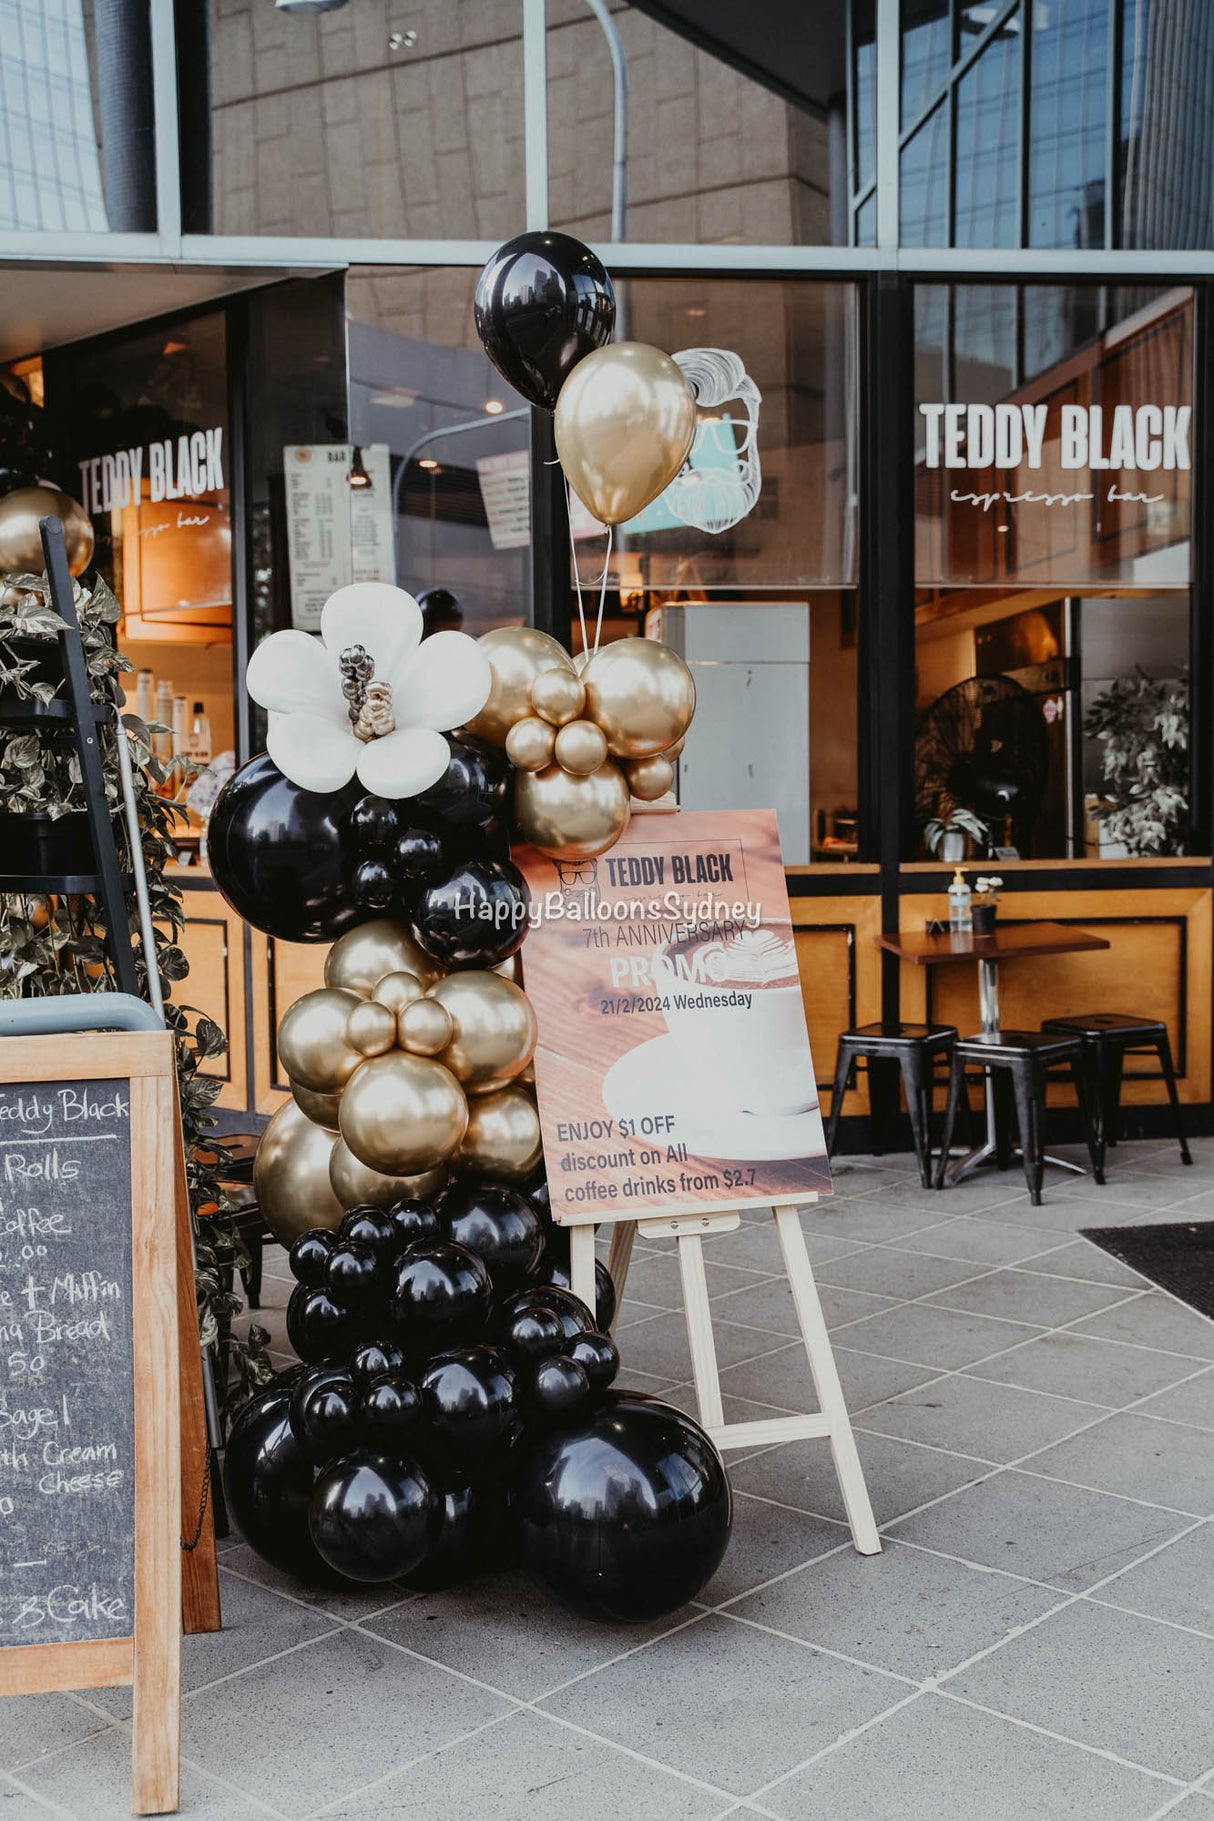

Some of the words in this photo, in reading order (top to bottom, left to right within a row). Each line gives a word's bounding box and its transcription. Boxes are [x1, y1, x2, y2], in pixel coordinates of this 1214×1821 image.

[918, 403, 1048, 469] TEDDY
[1060, 404, 1192, 471] BLACK
[78, 446, 143, 515] TEDDY
[149, 427, 224, 503] BLACK
[950, 488, 1095, 513] espresso
[1107, 484, 1165, 504] bar
[605, 856, 665, 887] TEDDY
[671, 853, 734, 884] BLACK
[582, 926, 610, 948] 7th
[616, 919, 746, 947] ANNIVERSARY
[601, 996, 671, 1015] 21/2/2024
[673, 990, 752, 1010] Wednesday
[57, 1088, 130, 1122] Black
[557, 1119, 614, 1142] ENJOY
[618, 1118, 636, 1139] $1
[640, 1114, 675, 1136] OFF
[5, 1148, 82, 1183] Rolls
[560, 1148, 636, 1172] discount
[640, 1150, 661, 1165] on
[666, 1142, 688, 1164] All
[564, 1180, 618, 1202] coffee
[622, 1175, 676, 1197] drinks
[679, 1172, 720, 1191] from
[723, 1168, 756, 1190] $2.7
[24, 1310, 111, 1344] Bread
[43, 1440, 118, 1466] Cream
[39, 1469, 125, 1495] Cheese
